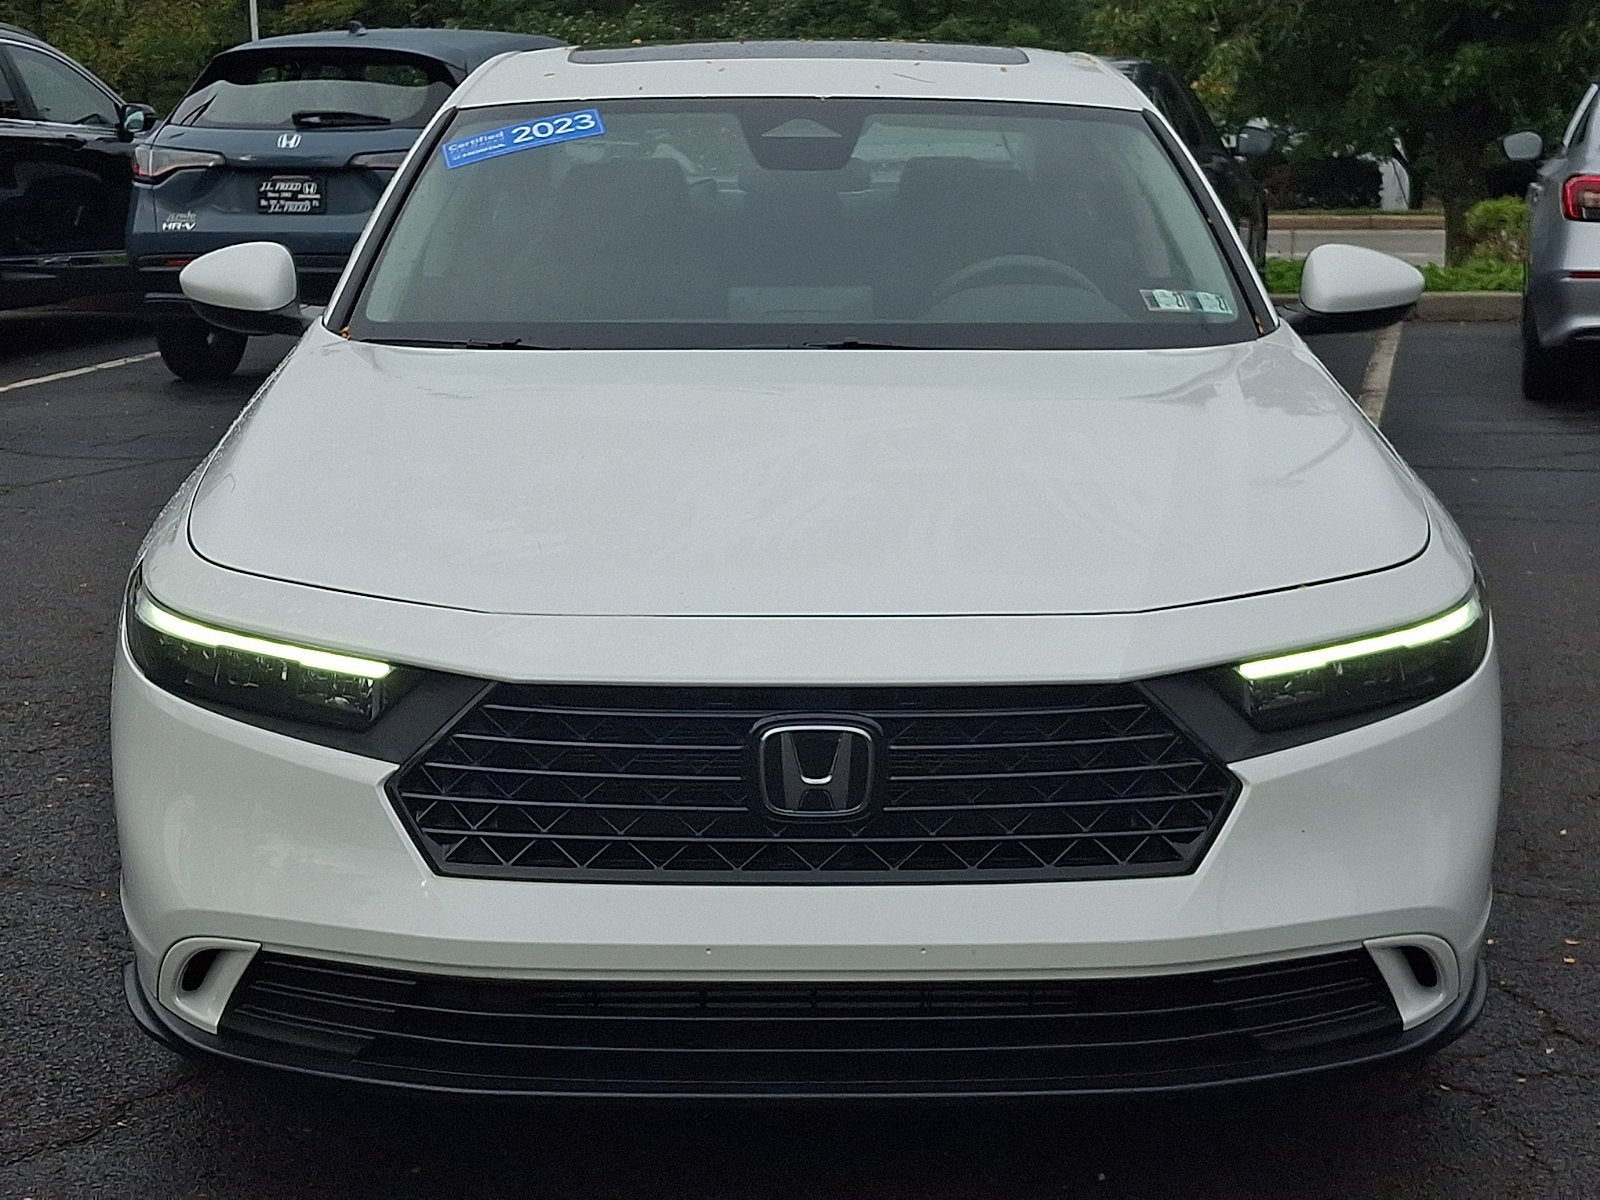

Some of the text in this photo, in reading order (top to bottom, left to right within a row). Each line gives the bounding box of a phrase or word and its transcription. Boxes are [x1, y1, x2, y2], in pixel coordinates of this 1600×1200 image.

[511, 114, 596, 144] 2023
[448, 130, 504, 151] Certified
[162, 222, 197, 231] HR-V
